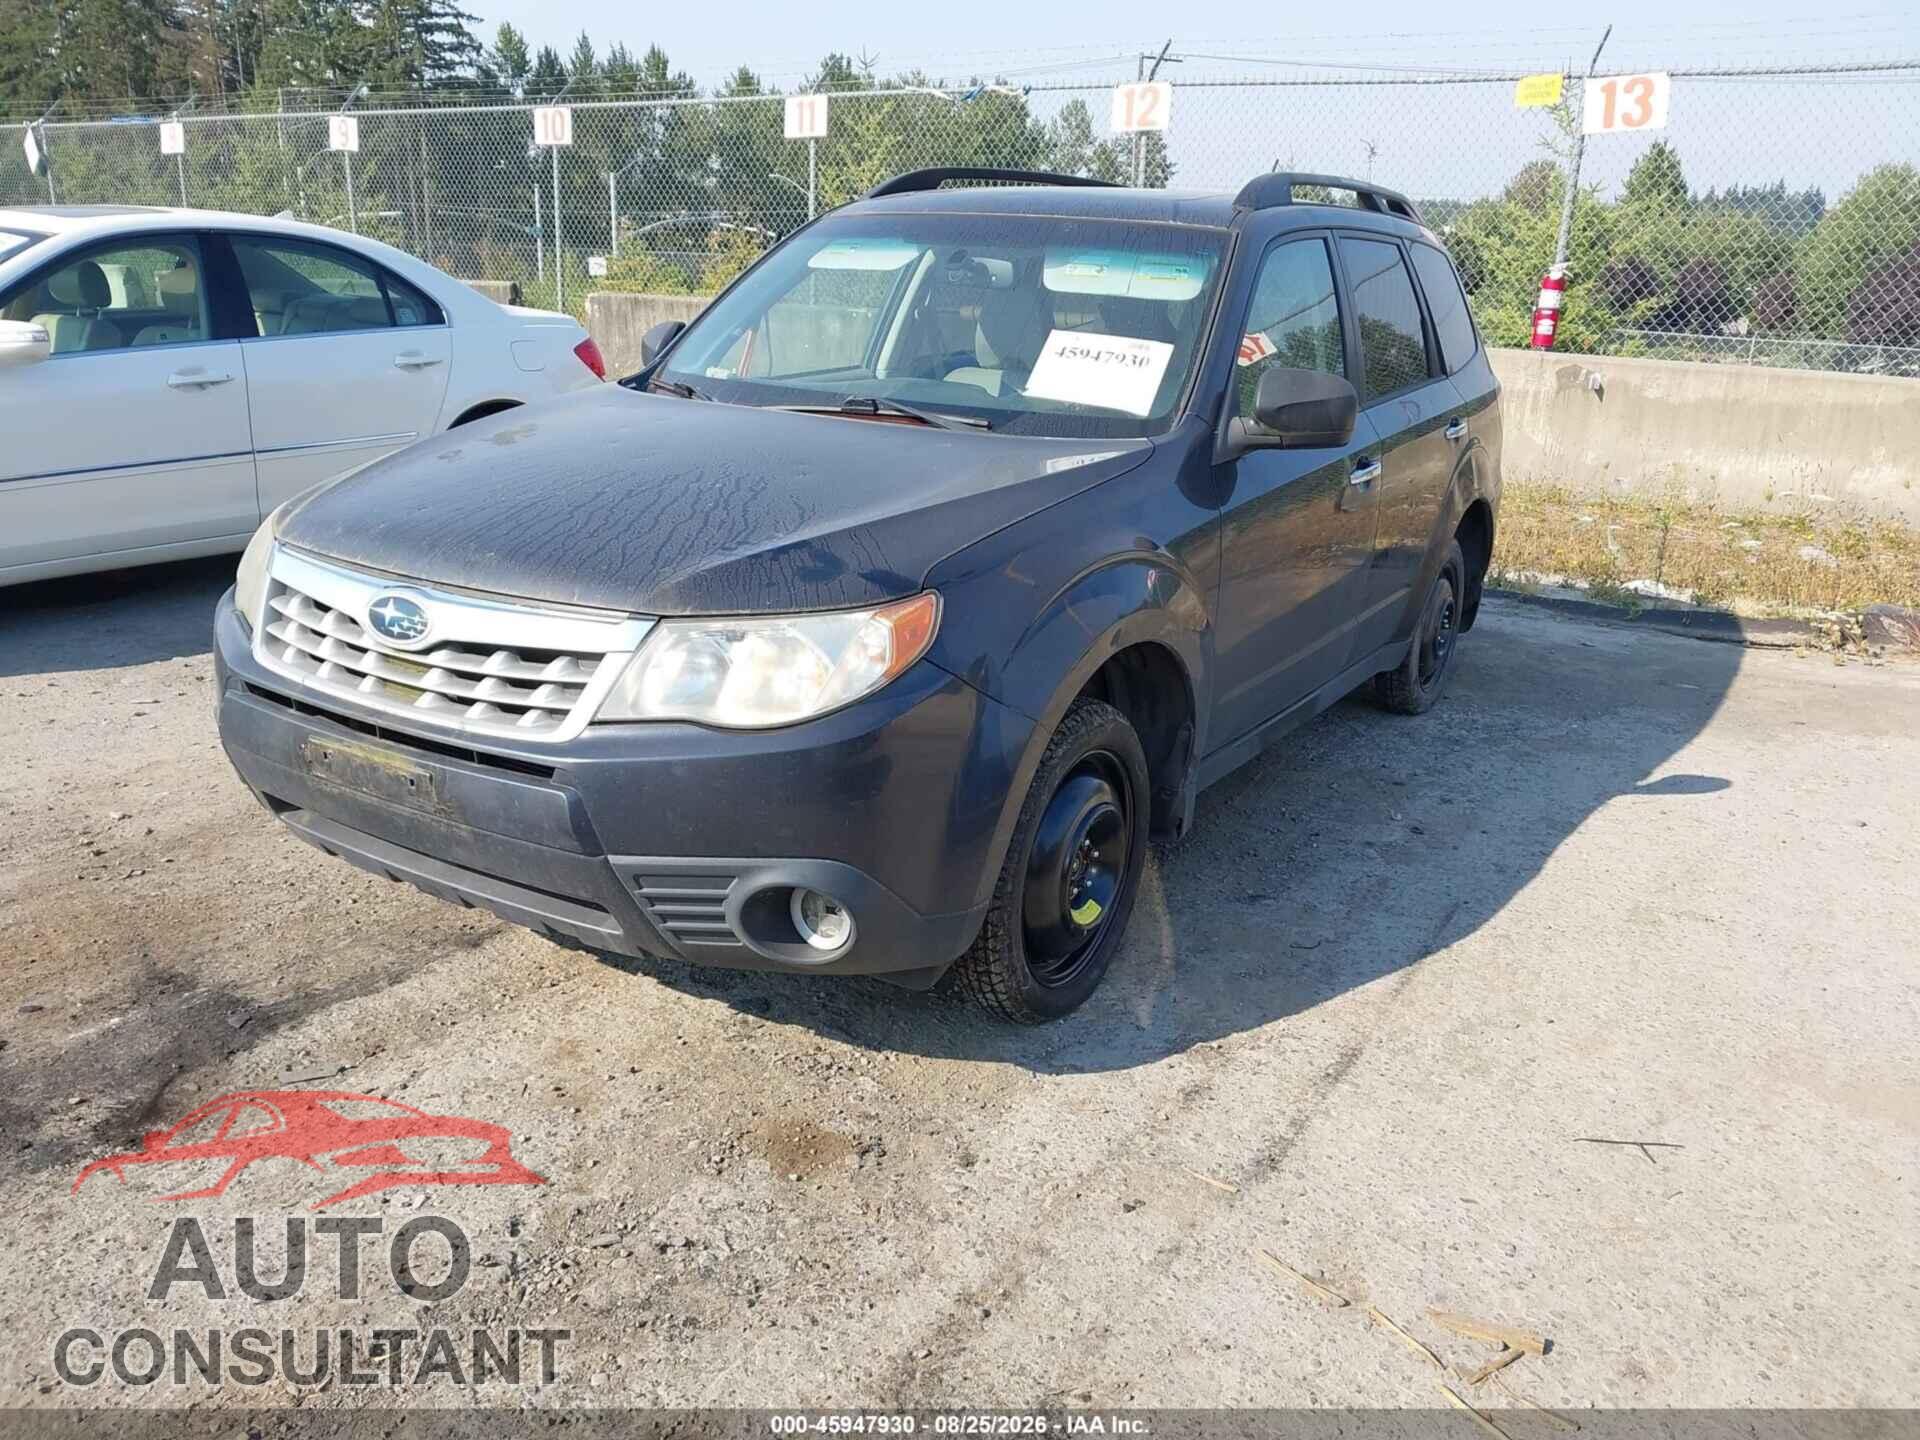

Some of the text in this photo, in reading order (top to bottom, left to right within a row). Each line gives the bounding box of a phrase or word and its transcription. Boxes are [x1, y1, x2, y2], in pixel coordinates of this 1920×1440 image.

[797, 100, 816, 133] 11
[1123, 86, 1161, 128] 12
[1600, 76, 1655, 130] 13
[338, 119, 350, 148] 9
[542, 109, 565, 141] 10
[1054, 346, 1151, 368] 45947930
